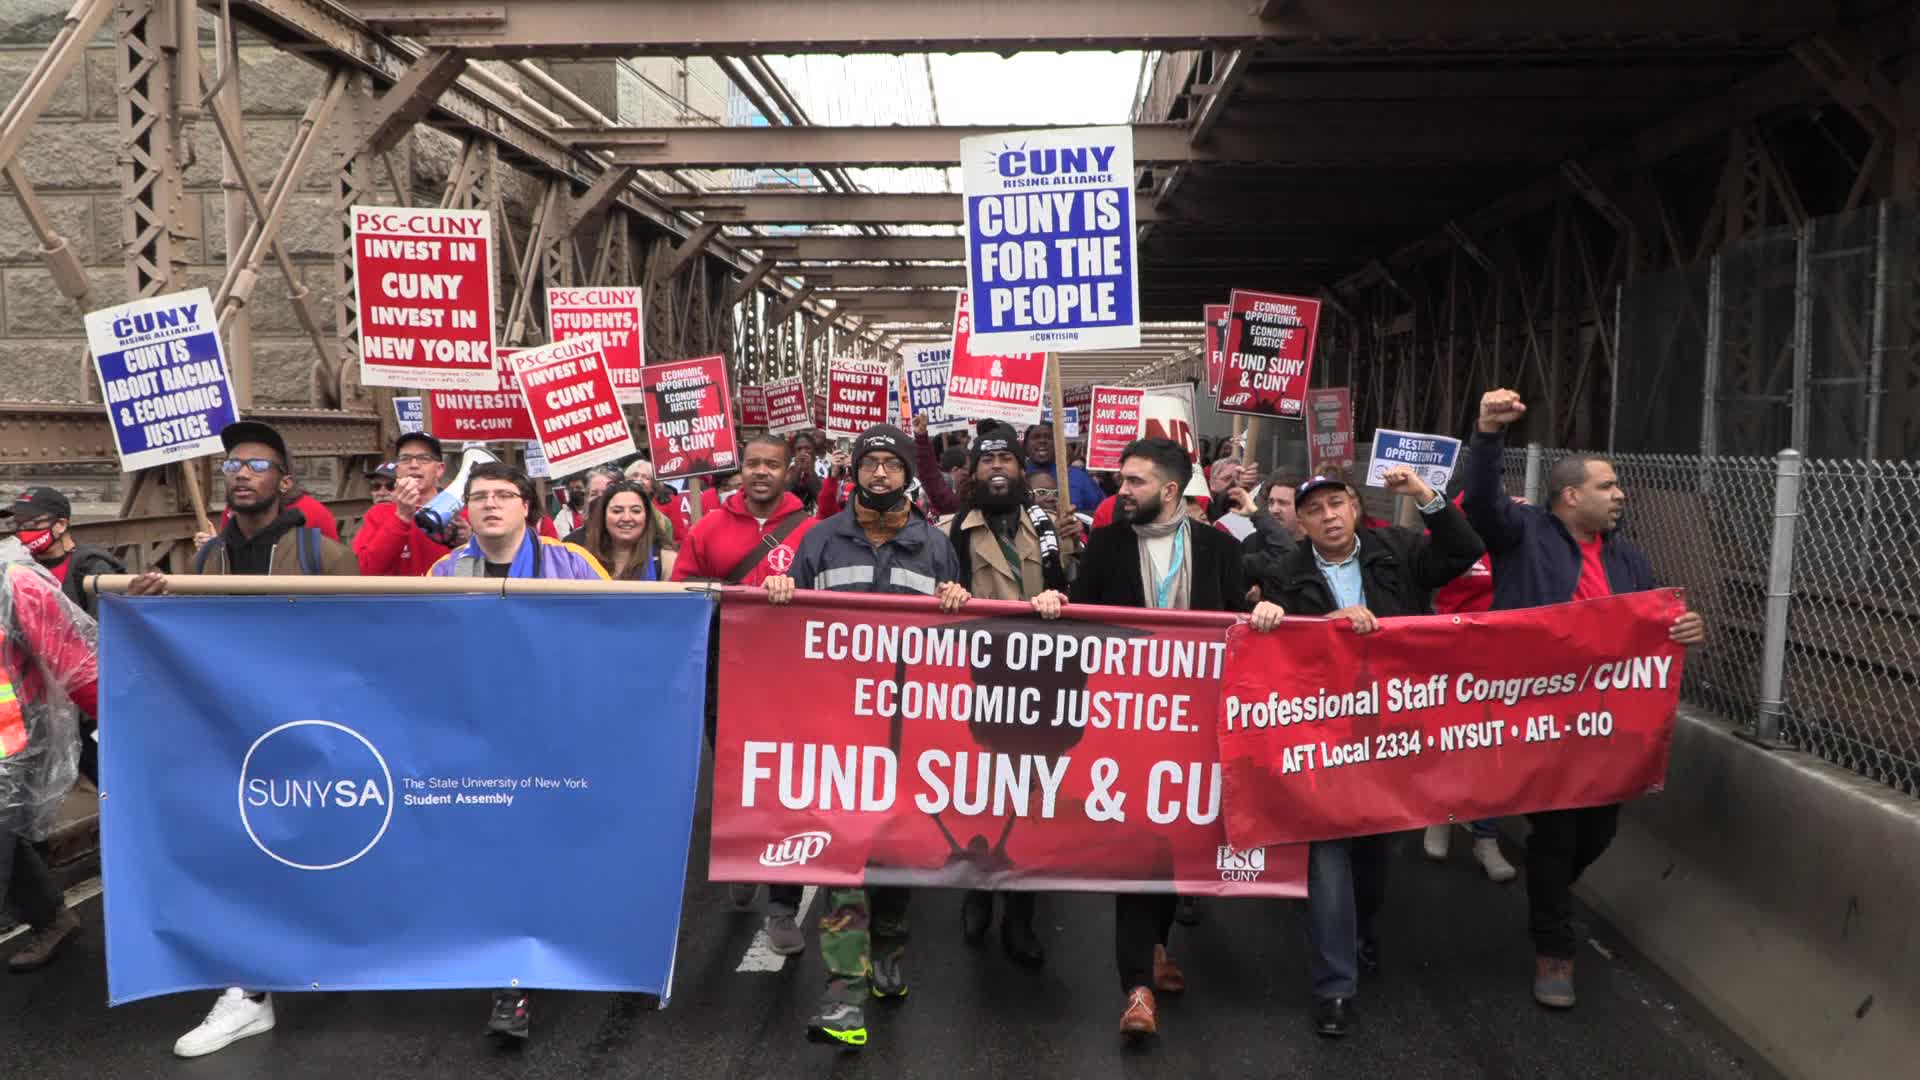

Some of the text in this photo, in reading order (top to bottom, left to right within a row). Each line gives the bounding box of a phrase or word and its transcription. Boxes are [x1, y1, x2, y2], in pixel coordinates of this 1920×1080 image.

[999, 146, 1115, 177] CUNY
[1003, 174, 1114, 188] RISING ALLIANCE
[356, 213, 482, 235] PSC-CUNY
[977, 190, 1120, 237] CUNY IS
[365, 239, 476, 262] INVEST IN
[980, 236, 1122, 282] FOR THE
[381, 272, 463, 300] CUNY
[550, 291, 635, 305] PSC-CUNY
[990, 282, 1116, 327] PEOPLE
[1254, 301, 1297, 316] ECONOMIC
[113, 304, 198, 338] CUNY
[371, 306, 477, 328] INVEST IN
[553, 312, 637, 332] STUDENTS,
[1245, 310, 1303, 327] OPPORTUNITY.
[120, 325, 200, 346] RISING ALLIANCE
[1250, 326, 1294, 340] ECONOMIC
[1252, 336, 1287, 350] JUSTICE.
[124, 339, 190, 373] CUNY IS
[364, 336, 489, 363] NEW YORK
[515, 338, 595, 370] PSC-CUNY
[918, 349, 951, 363] CUN
[527, 362, 577, 388] INVEST
[579, 356, 598, 373] IN
[661, 366, 704, 381] ECONOMIC
[831, 361, 887, 374] PSC-CUNY
[990, 360, 1003, 378] &
[1230, 352, 1266, 372] FUND
[1268, 356, 1305, 376] SUNY
[107, 359, 224, 403] ABOUT RACIAL
[656, 374, 712, 392] OPPORTUNITY.
[833, 372, 868, 384] INVEST
[871, 377, 883, 386] IN
[949, 376, 1040, 402] STAFF UNITED
[1239, 371, 1290, 392] & CUNY
[120, 385, 222, 427] & ECONOMIC
[435, 393, 527, 410] UNIVERSITY
[546, 381, 595, 410] CUNY
[664, 388, 707, 404] ECONOMIC
[773, 395, 796, 407] CUNY
[839, 388, 876, 403] CUNY
[913, 388, 940, 407] FOR
[1098, 393, 1116, 404] SAVE
[544, 401, 613, 433] INVEST IN
[786, 413, 806, 423] YORK
[832, 403, 881, 416] INVEST IN
[1096, 409, 1116, 419] SAVE
[144, 414, 211, 447] JUSTICE
[455, 418, 513, 430] PSC-CUNY
[654, 413, 726, 439] FUND SUNY
[829, 416, 852, 429] NEW
[1096, 424, 1115, 434] SAVE
[544, 433, 583, 459] NEW
[583, 419, 627, 446] YORK
[668, 432, 715, 453] & CUNY
[1399, 437, 1436, 451] RESTORE
[1385, 447, 1444, 464] OPPORTUNITY
[804, 620, 1225, 679] ECONOMIC OPPORTUNIT
[1226, 681, 1379, 730] Professional
[1386, 674, 1449, 714] Staff
[1455, 670, 1576, 707] Congress
[1593, 655, 1673, 691] CUNY
[854, 678, 1200, 733] ECONOMIC JUSTICE.
[1282, 742, 1317, 775] AFT
[1321, 735, 1370, 768] Local
[1376, 728, 1422, 759] 2334
[1440, 720, 1504, 753] NYSUT
[1525, 713, 1562, 743] AFL
[1577, 711, 1613, 737] CIO
[403, 777, 588, 791] The State University of New York
[741, 740, 1222, 825] FUND SUNY & CU
[404, 793, 514, 807] Student Assembly
[1218, 847, 1263, 869] PSC
[1221, 870, 1260, 882] CUNY
